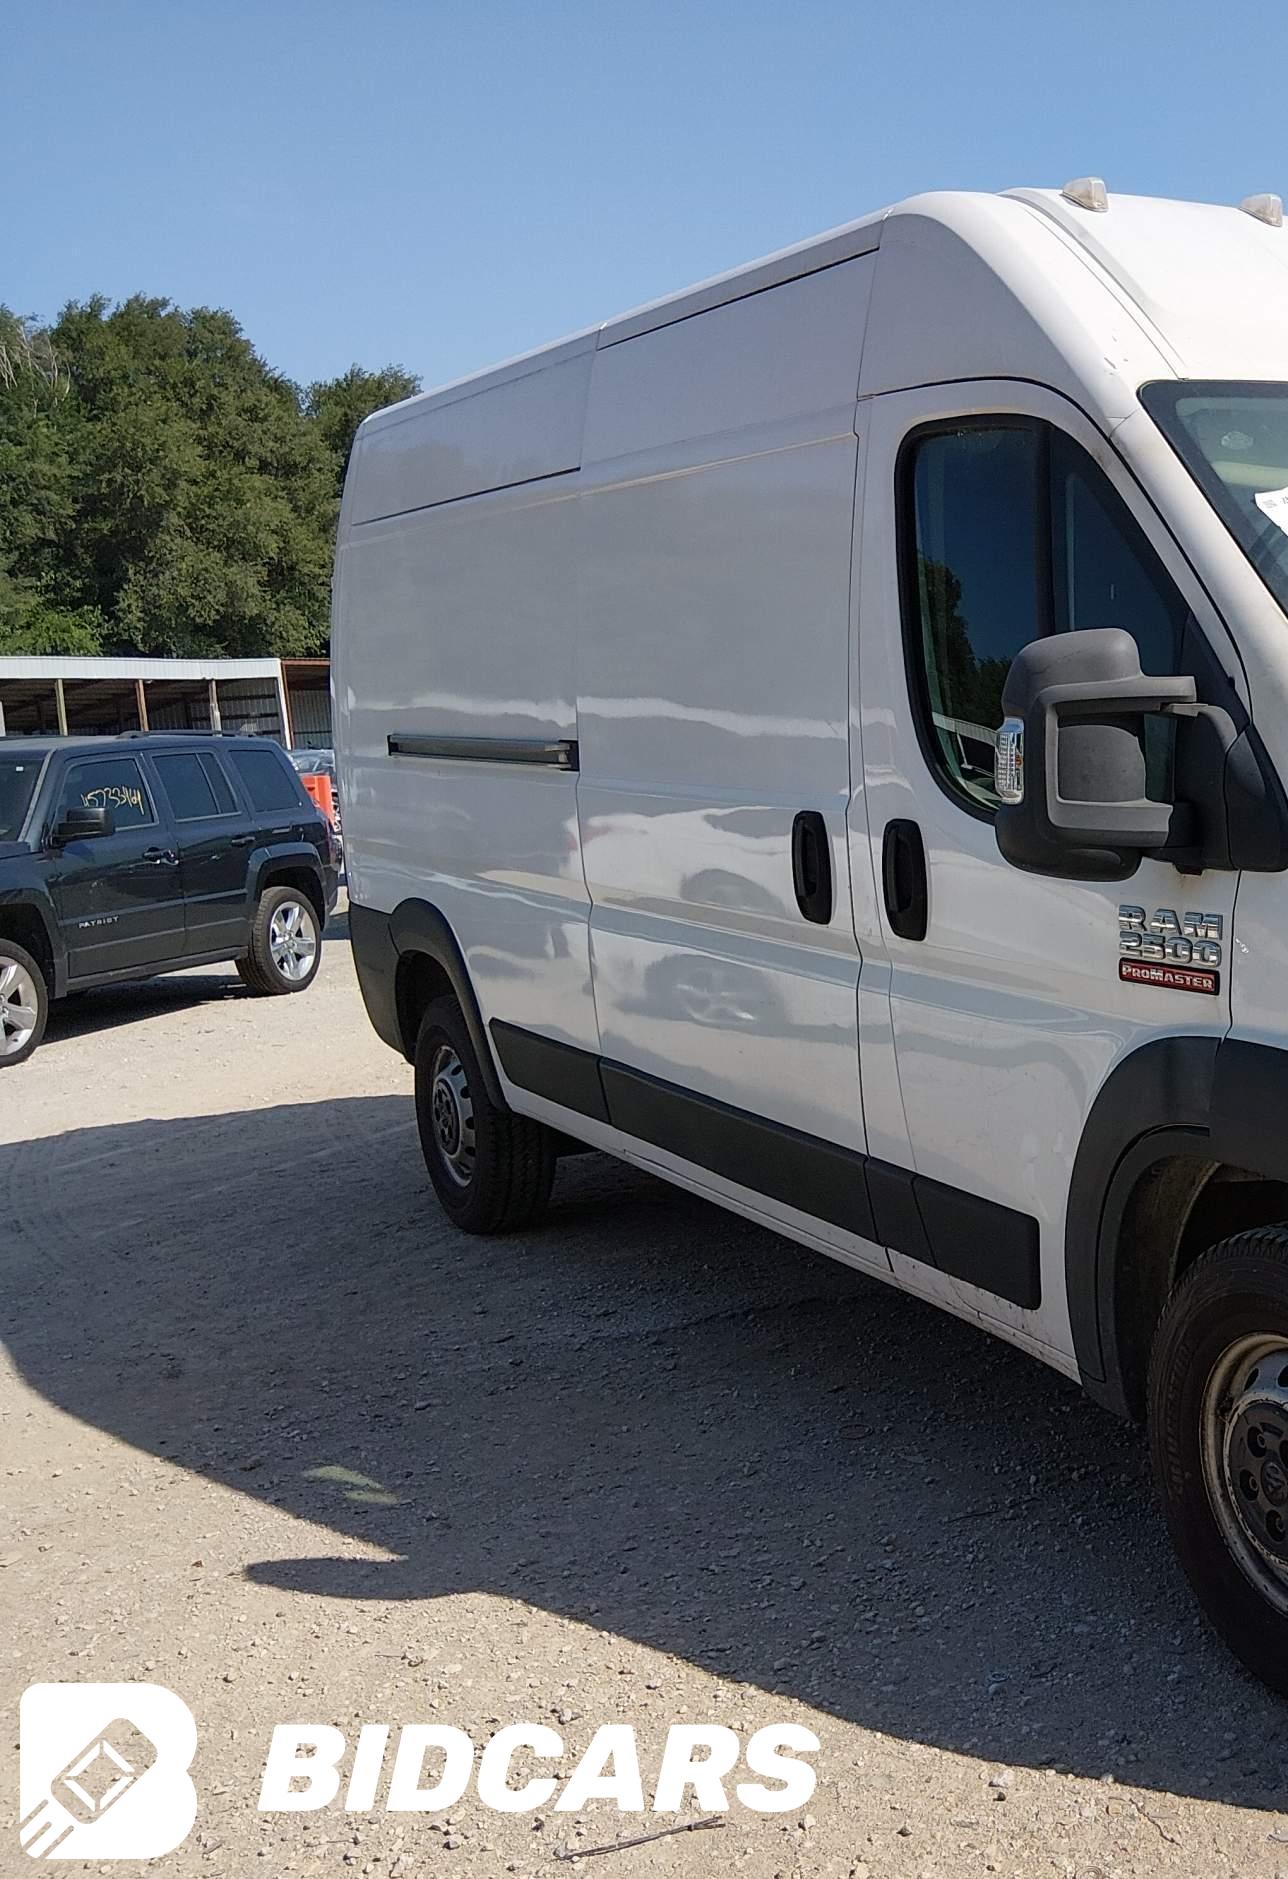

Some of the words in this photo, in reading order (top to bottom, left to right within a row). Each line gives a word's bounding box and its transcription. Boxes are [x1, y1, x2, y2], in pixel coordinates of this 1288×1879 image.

[78, 915, 119, 929] PATRIOT
[1118, 904, 1223, 941] RAM
[1120, 931, 1222, 967] 2500
